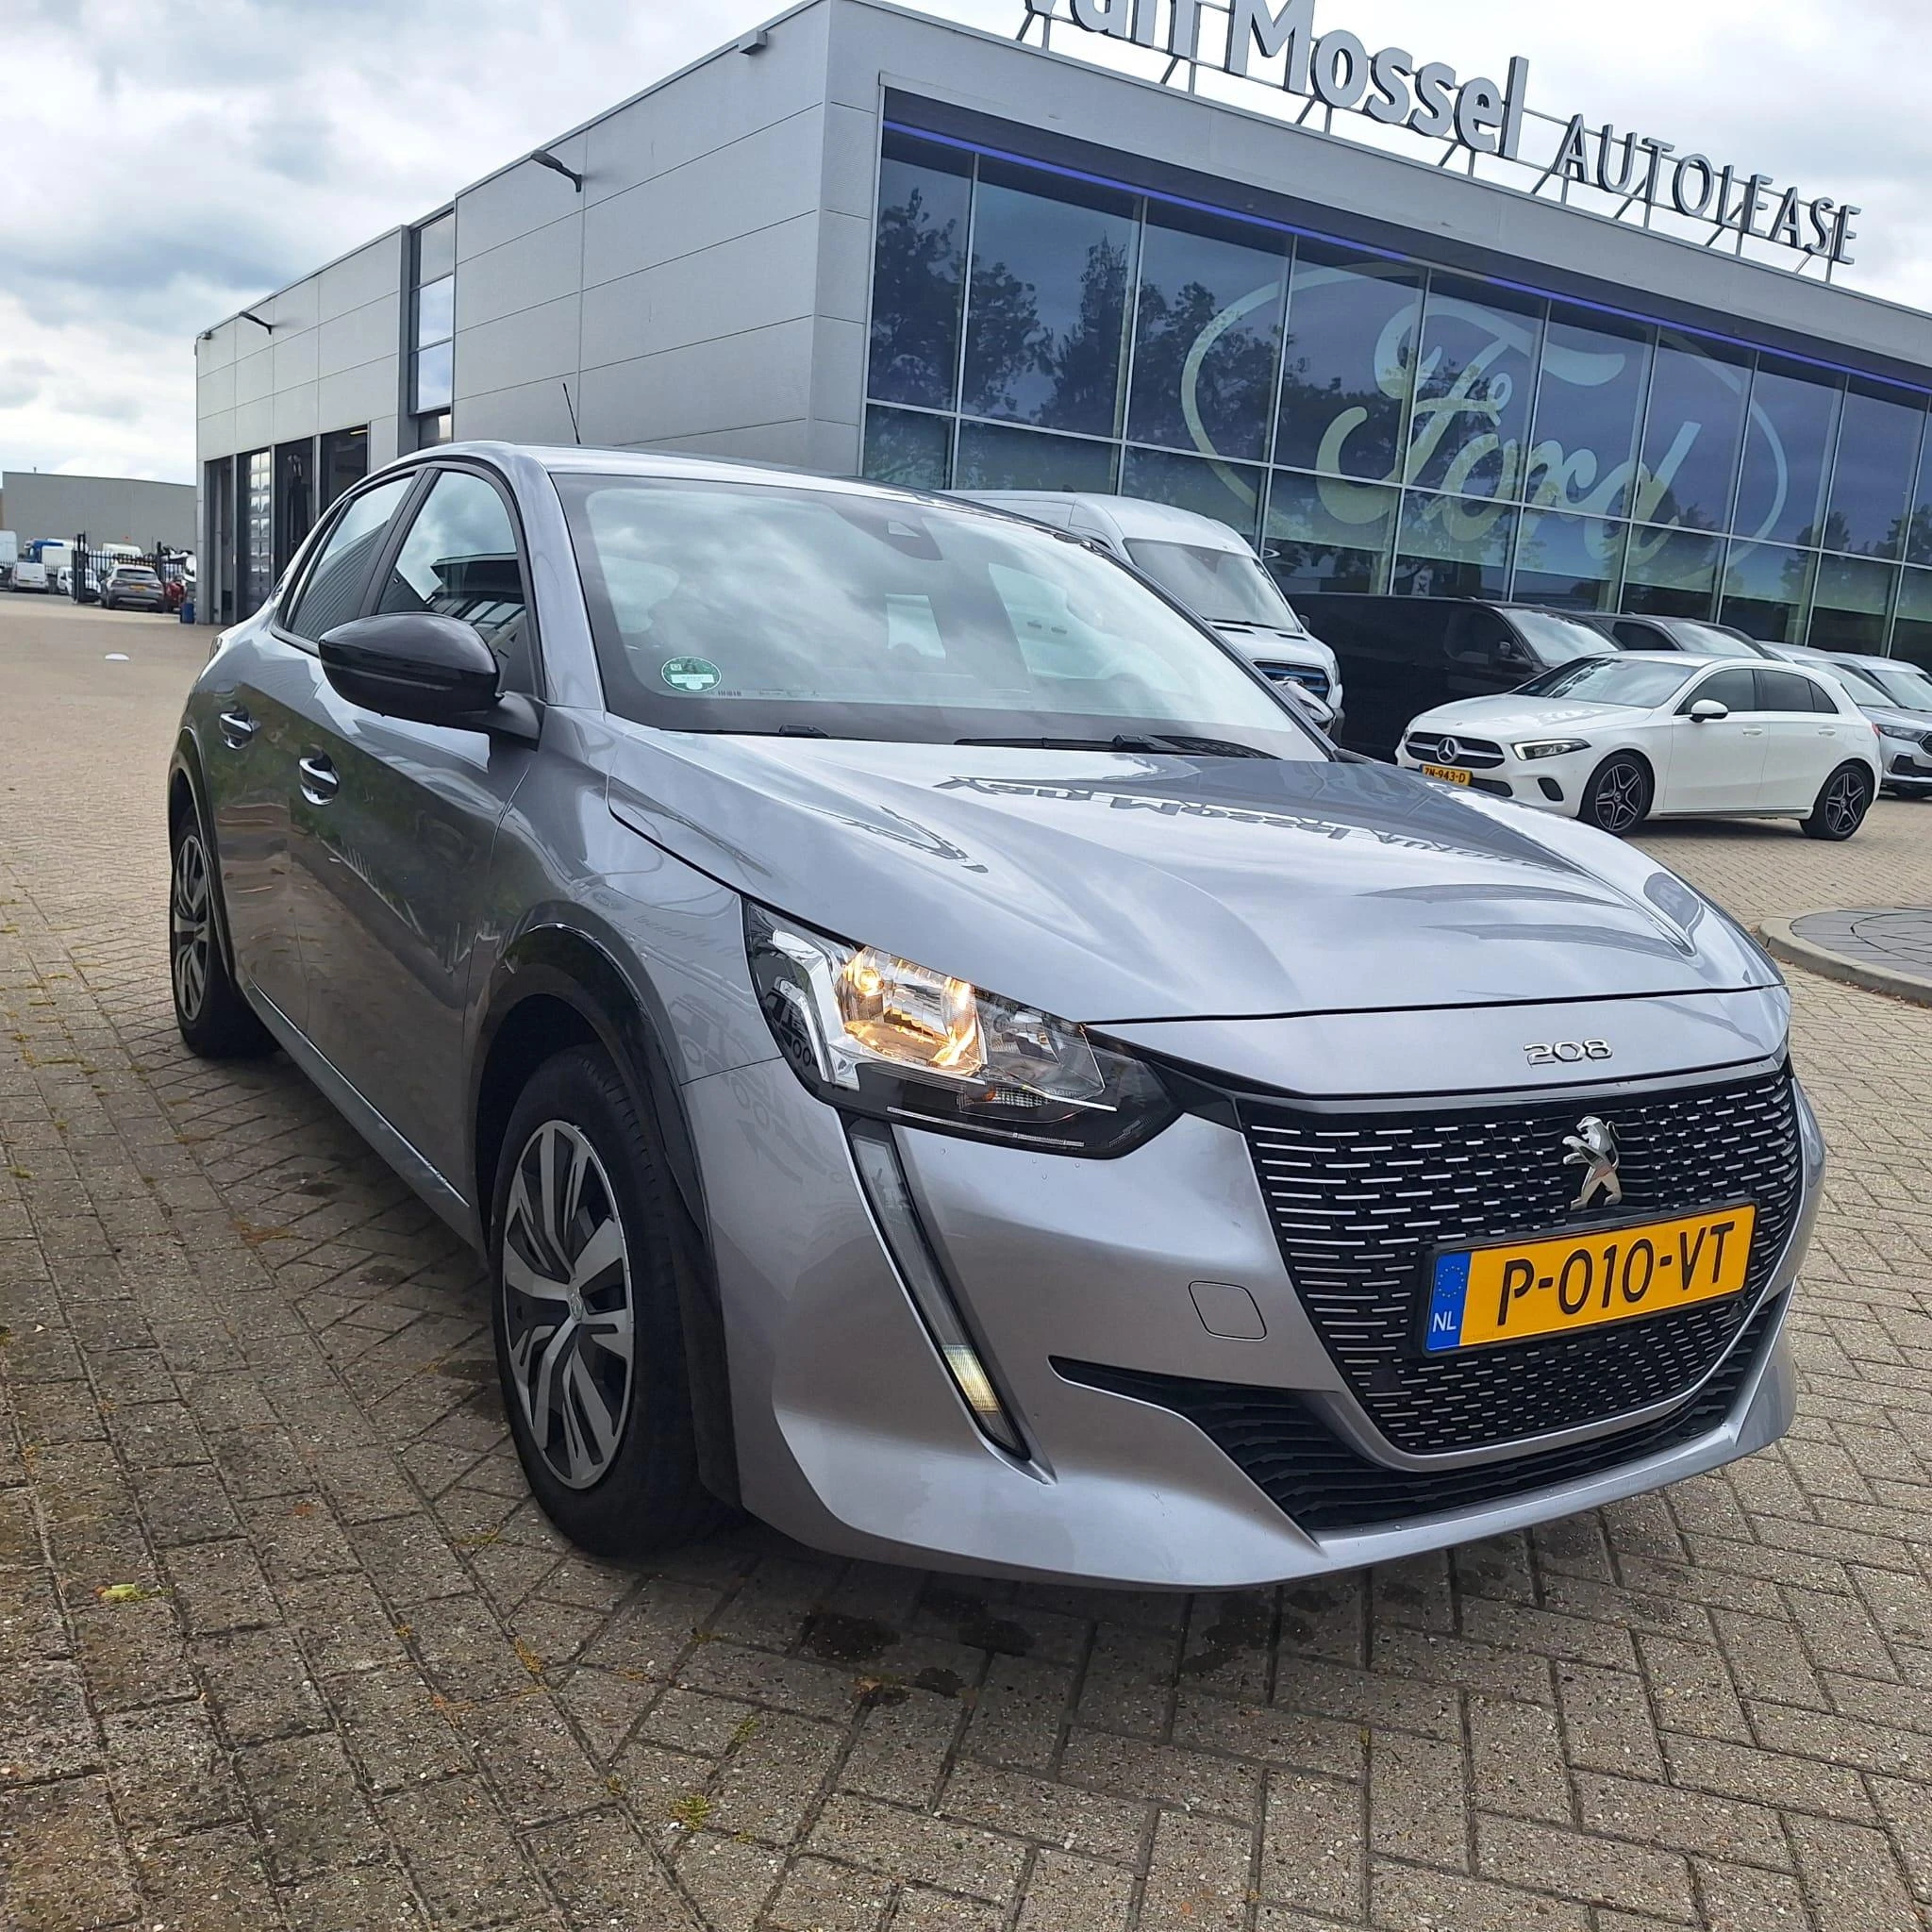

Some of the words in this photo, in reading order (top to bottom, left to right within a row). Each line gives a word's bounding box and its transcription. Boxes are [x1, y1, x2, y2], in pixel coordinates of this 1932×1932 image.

[1225, 0, 1529, 159] Mossel
[1550, 113, 1862, 265] AUTOLEASE
[1316, 296, 1703, 567] Ford
[1524, 1039, 1613, 1067] 208
[1432, 1310, 1457, 1333] NL
[1497, 1222, 1735, 1326] P-010-VT
